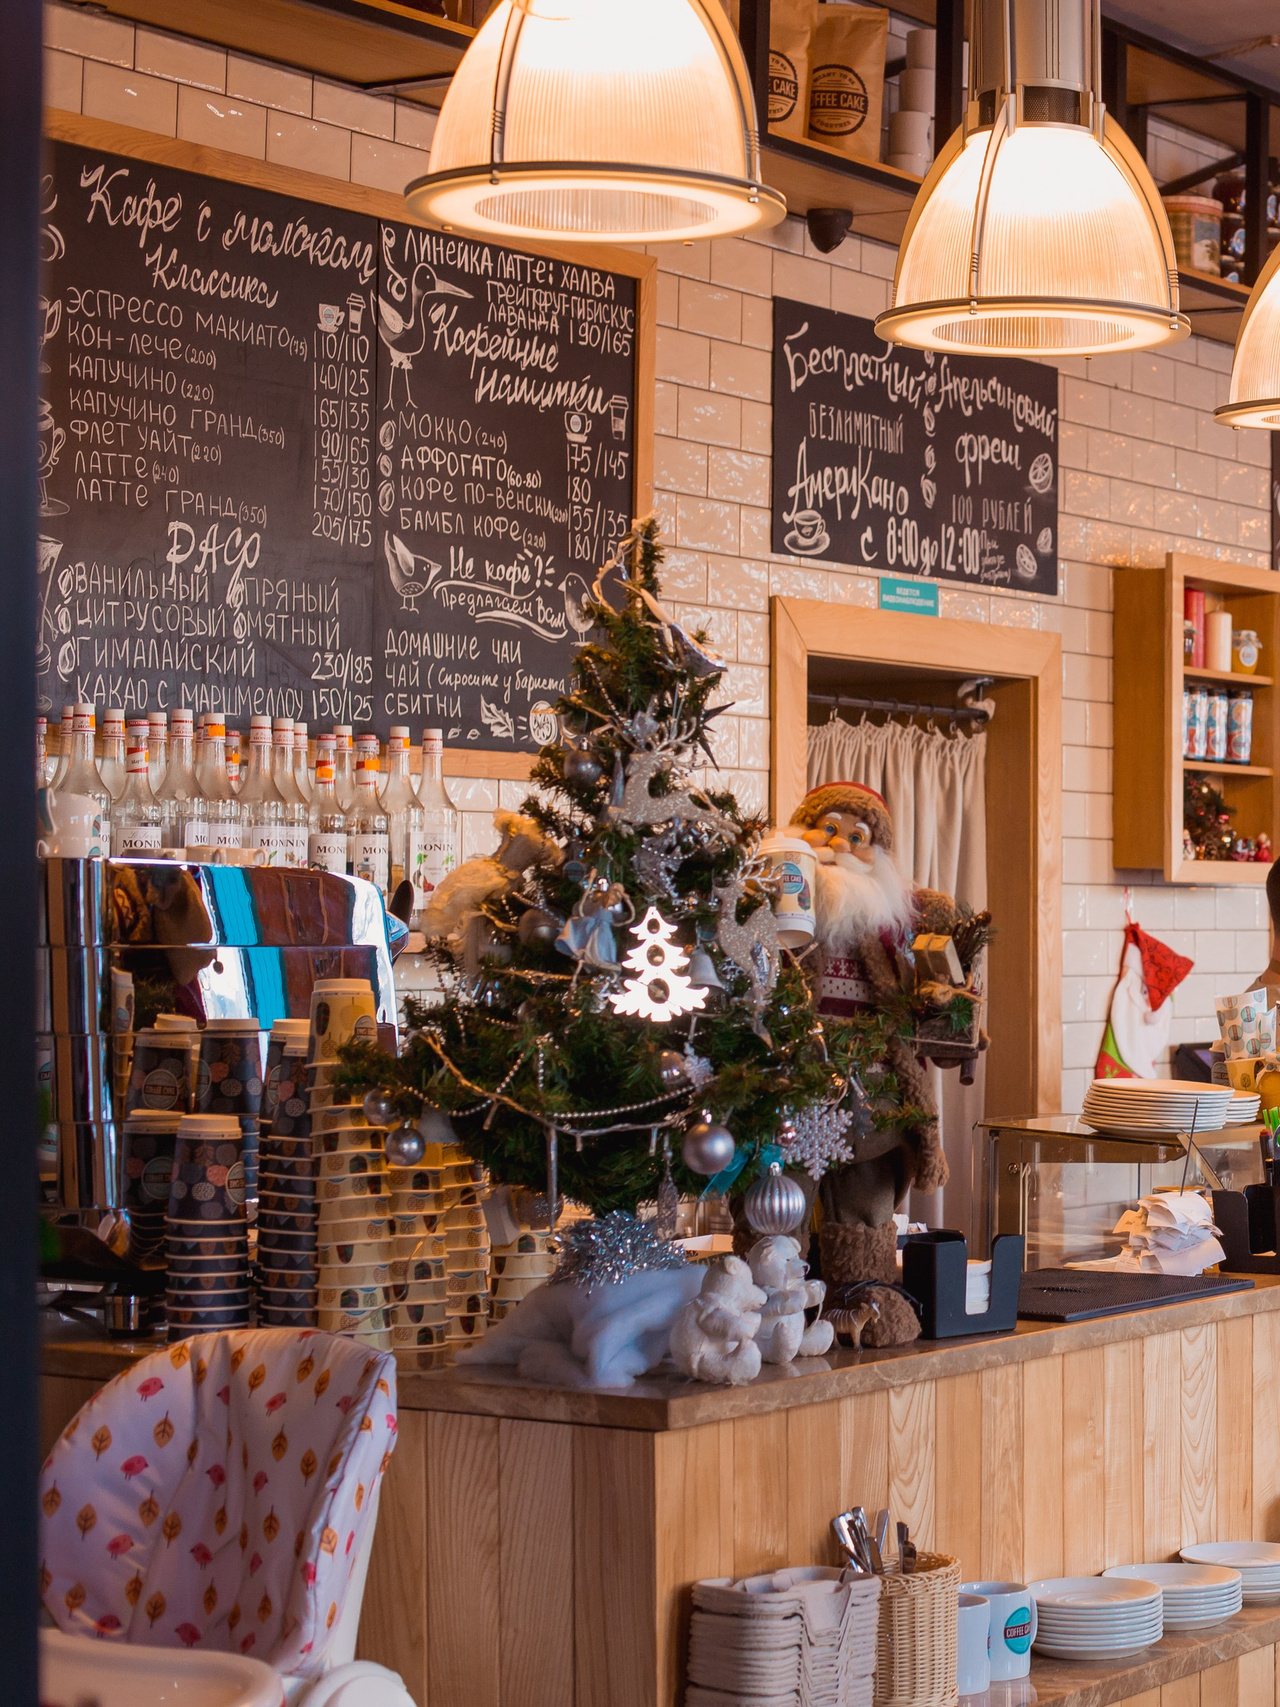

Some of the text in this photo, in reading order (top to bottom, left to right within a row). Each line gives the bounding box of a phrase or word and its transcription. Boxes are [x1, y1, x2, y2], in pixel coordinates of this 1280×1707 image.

[773, 79, 796, 98] CAKE
[840, 93, 865, 111] CAKE
[80, 164, 183, 249] Кофе
[222, 209, 378, 285] молоком
[560, 264, 616, 301] ХАЛВА
[313, 330, 370, 364] 110/110
[487, 302, 632, 358] ЛАВАНДА 190/165
[313, 361, 370, 398] 140/125
[783, 321, 926, 409] Бесплатный
[68, 352, 370, 432] КАПУЧИНО (220) 165/135
[934, 356, 1058, 442] Апельсиновый
[69, 388, 177, 428] КАПУЧИНО
[190, 408, 257, 442] ГРАНД
[809, 402, 904, 454] БЕЗЛИМИТНЫЙ
[138, 423, 192, 457] УАЙТ
[313, 429, 371, 466] 190/165
[399, 411, 630, 480] МОККО (240) 175/145
[400, 445, 507, 482] АФФОГАТО
[566, 474, 592, 505] 180
[165, 490, 238, 518] ГРАНД
[313, 484, 373, 518] 170/150
[567, 500, 629, 539] 155/135
[952, 494, 1033, 535] 100 РУБЛЕЙ
[311, 512, 373, 548] 205/175
[400, 507, 465, 536] БАМБЛ
[522, 527, 547, 552] (220)
[887, 516, 919, 568] 8:00
[941, 522, 980, 575] 12:00
[75, 561, 340, 616] ВАНИЛЬНЫЙ ПРЯНЫЙ
[76, 600, 341, 650] ЦИТРУСОВЫЙ МЯТНЫЙ
[76, 636, 374, 690] ГИМАЛАЙСКИЙ 230/185
[385, 660, 421, 688] ЧАЙ
[515, 668, 565, 702] бариста
[76, 671, 150, 710] КАКАО
[311, 687, 375, 725] 150/125
[384, 693, 462, 719] СБИТНИ
[417, 843, 453, 852] MONIN
[1006, 1625, 1024, 1638] COFFEE
